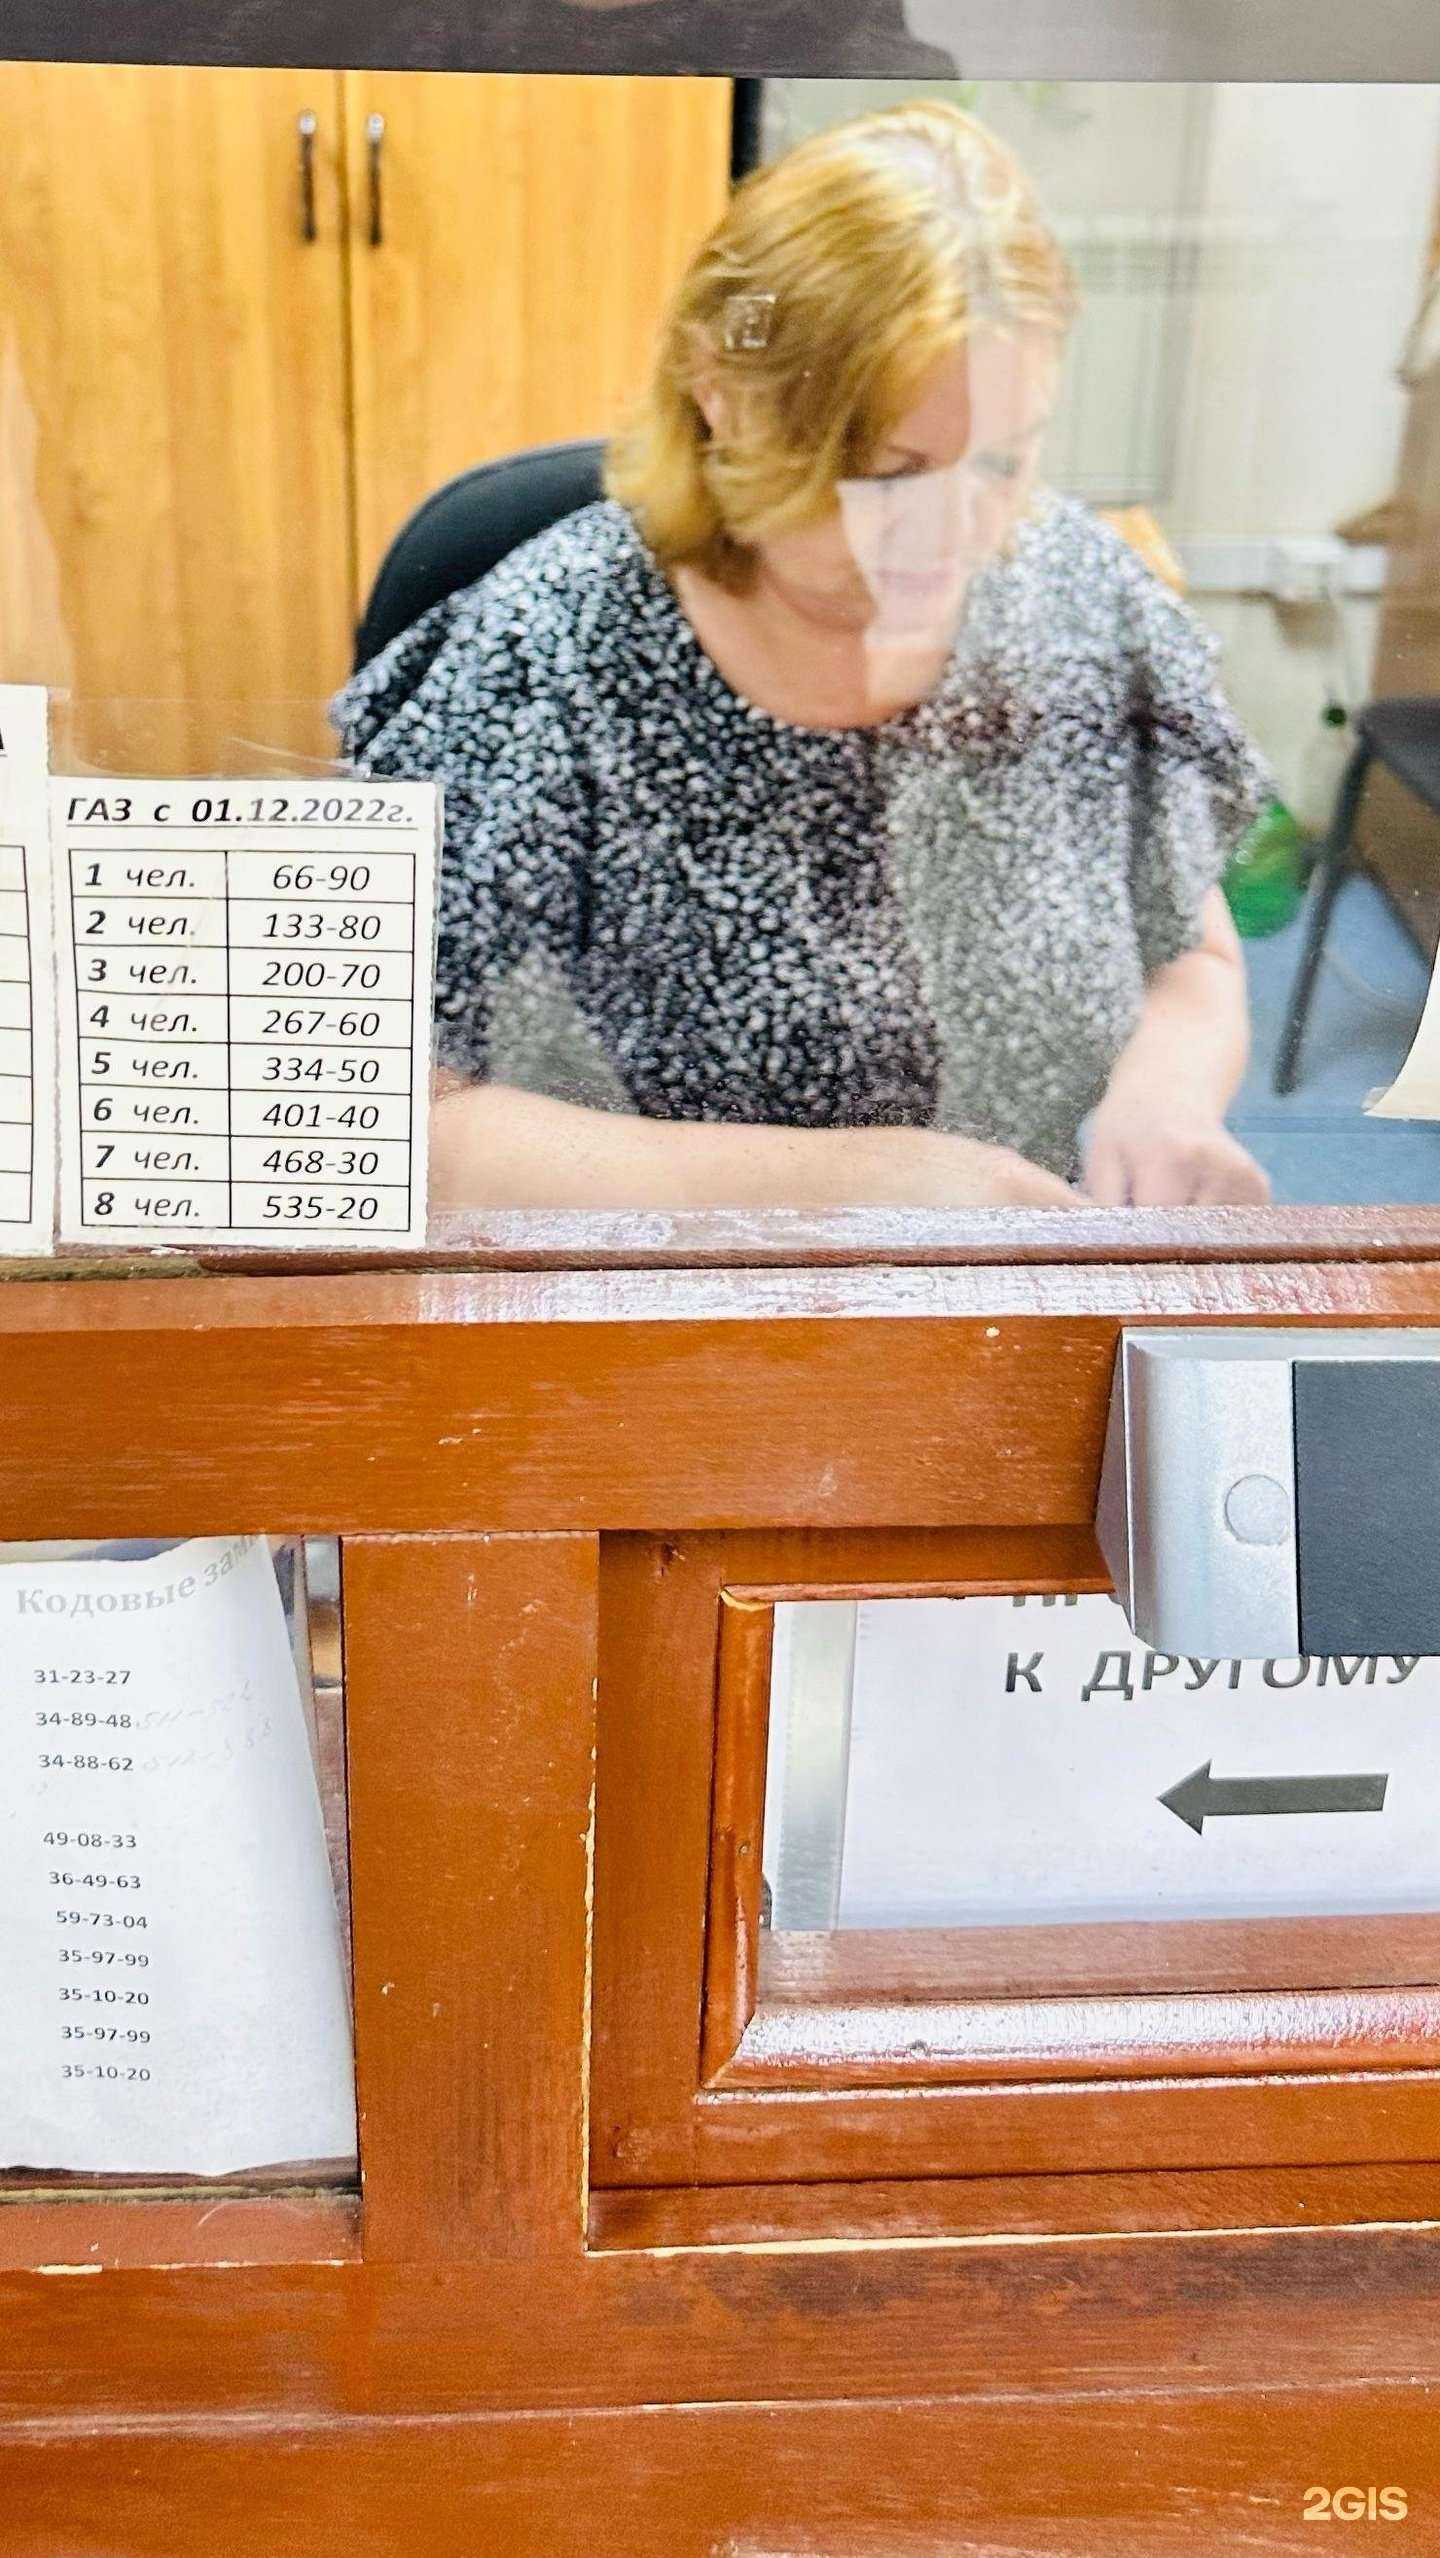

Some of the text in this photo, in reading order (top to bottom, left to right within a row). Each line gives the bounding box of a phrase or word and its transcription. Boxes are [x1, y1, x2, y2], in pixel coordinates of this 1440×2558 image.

[67, 797, 413, 823] ГАЗ с 01.12.2022г.
[84, 862, 371, 892] 1 чел. 66-90
[84, 909, 382, 941] 2 чел. 133-80
[87, 958, 381, 989] 3 чел. 200-70
[89, 1004, 381, 1037] 4 чел. 267-60
[90, 1050, 380, 1084] 5 чел. 334-50
[93, 1097, 380, 1130] 6 чел. 401-40
[94, 1144, 379, 1176] 7 чел. 468-30
[93, 1191, 379, 1221] 8 чел. 535-20
[17, 1575, 195, 1618] Кодовые
[34, 1669, 131, 1685] 31-23-27
[1005, 1652, 1045, 1692] К
[36, 1711, 132, 1729] 34-89-48
[39, 1754, 134, 1772] 34-88-62
[42, 1831, 137, 1849] 49-08-33
[49, 1871, 141, 1889] 36-49-63
[56, 1910, 148, 1929] 59-73-04
[59, 1949, 149, 1968] 35-97-99
[59, 1987, 149, 2006] 35-10-20
[62, 2026, 151, 2044] 35-97-99
[62, 2064, 151, 2082] 35-10-20
